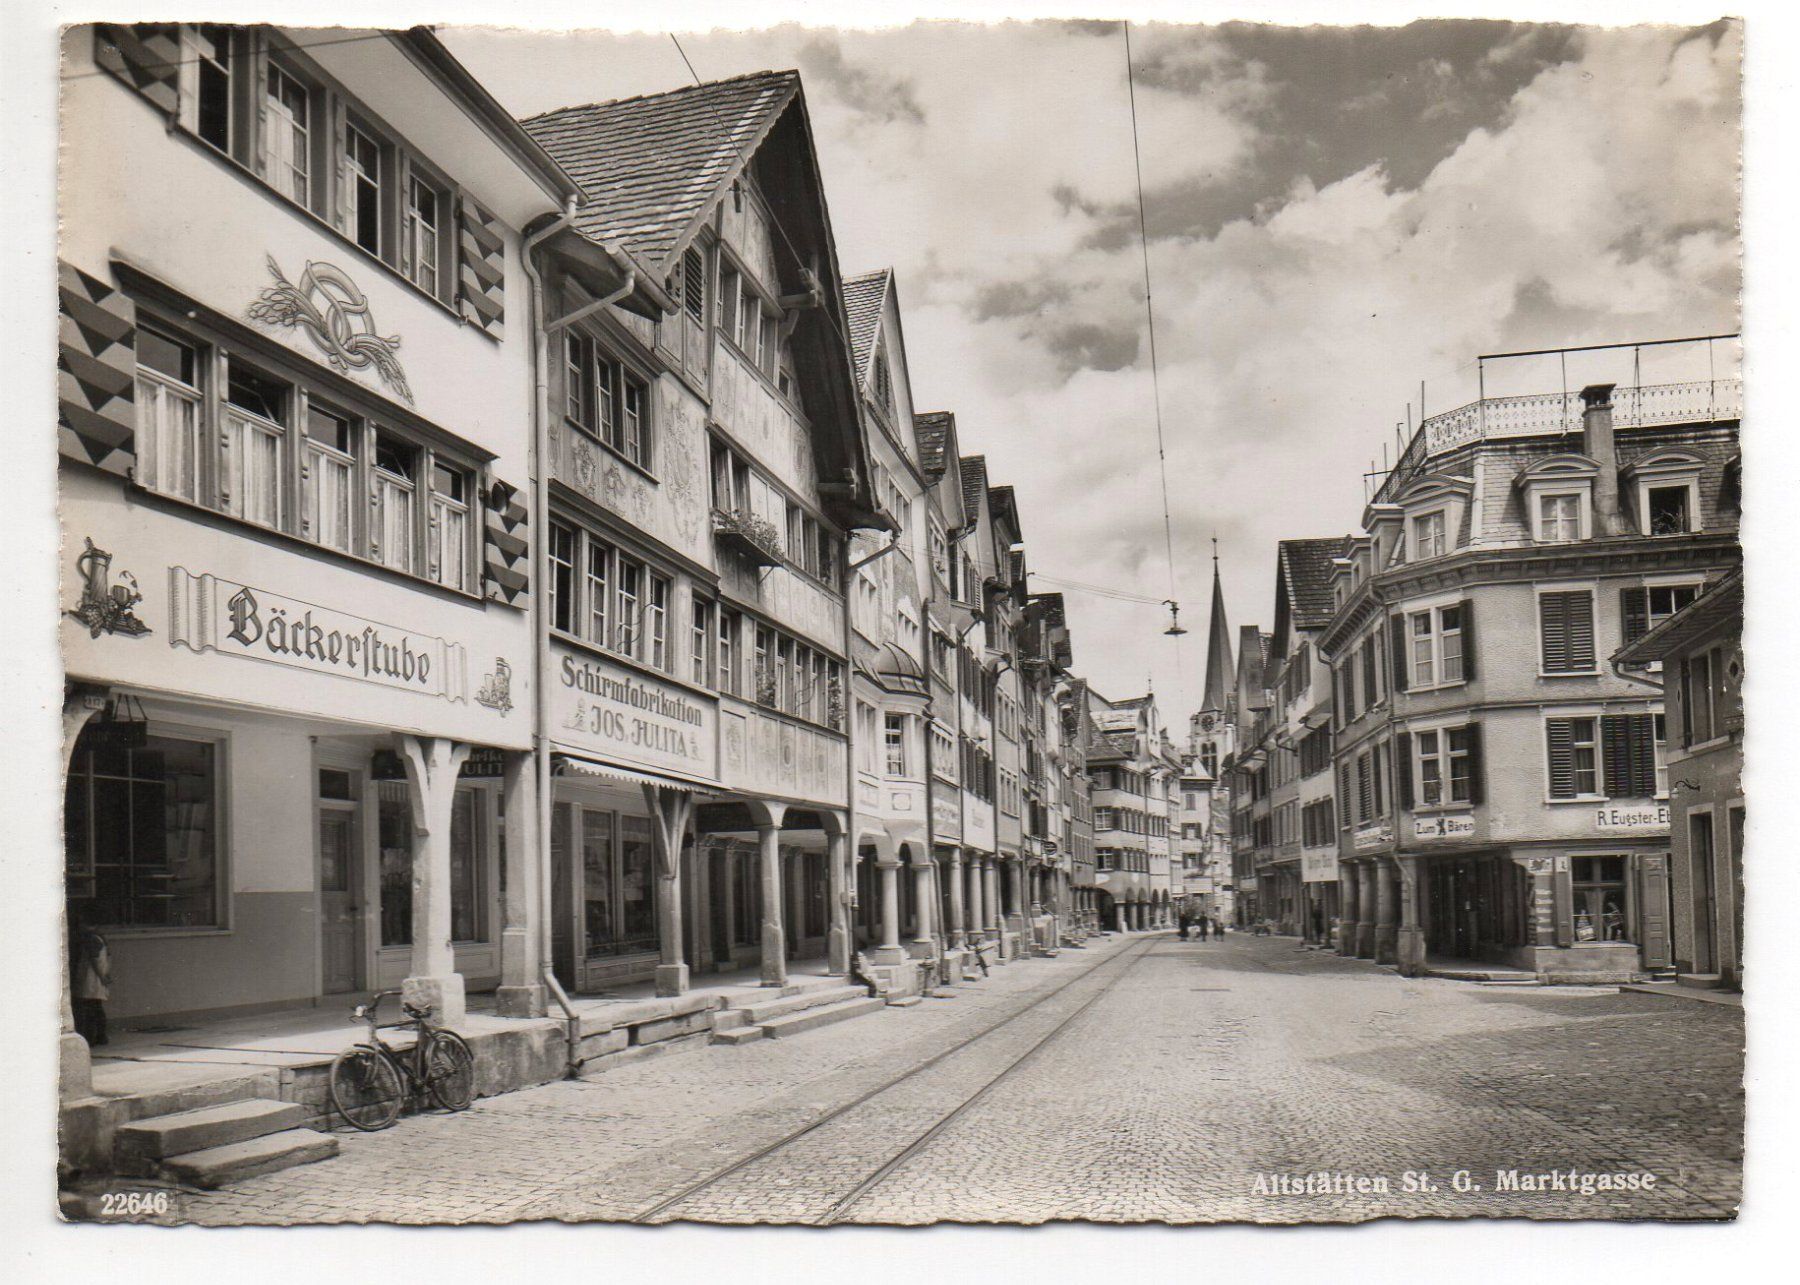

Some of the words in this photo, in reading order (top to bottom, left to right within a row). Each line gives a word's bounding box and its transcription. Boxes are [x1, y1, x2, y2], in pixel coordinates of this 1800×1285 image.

[561, 655, 702, 727] Schirmfabrikation
[591, 705, 629, 742] JOS.
[631, 716, 688, 758] JULITA
[464, 762, 504, 776] ULIT
[1416, 822, 1435, 834] Zum
[1448, 819, 1474, 832] Bären
